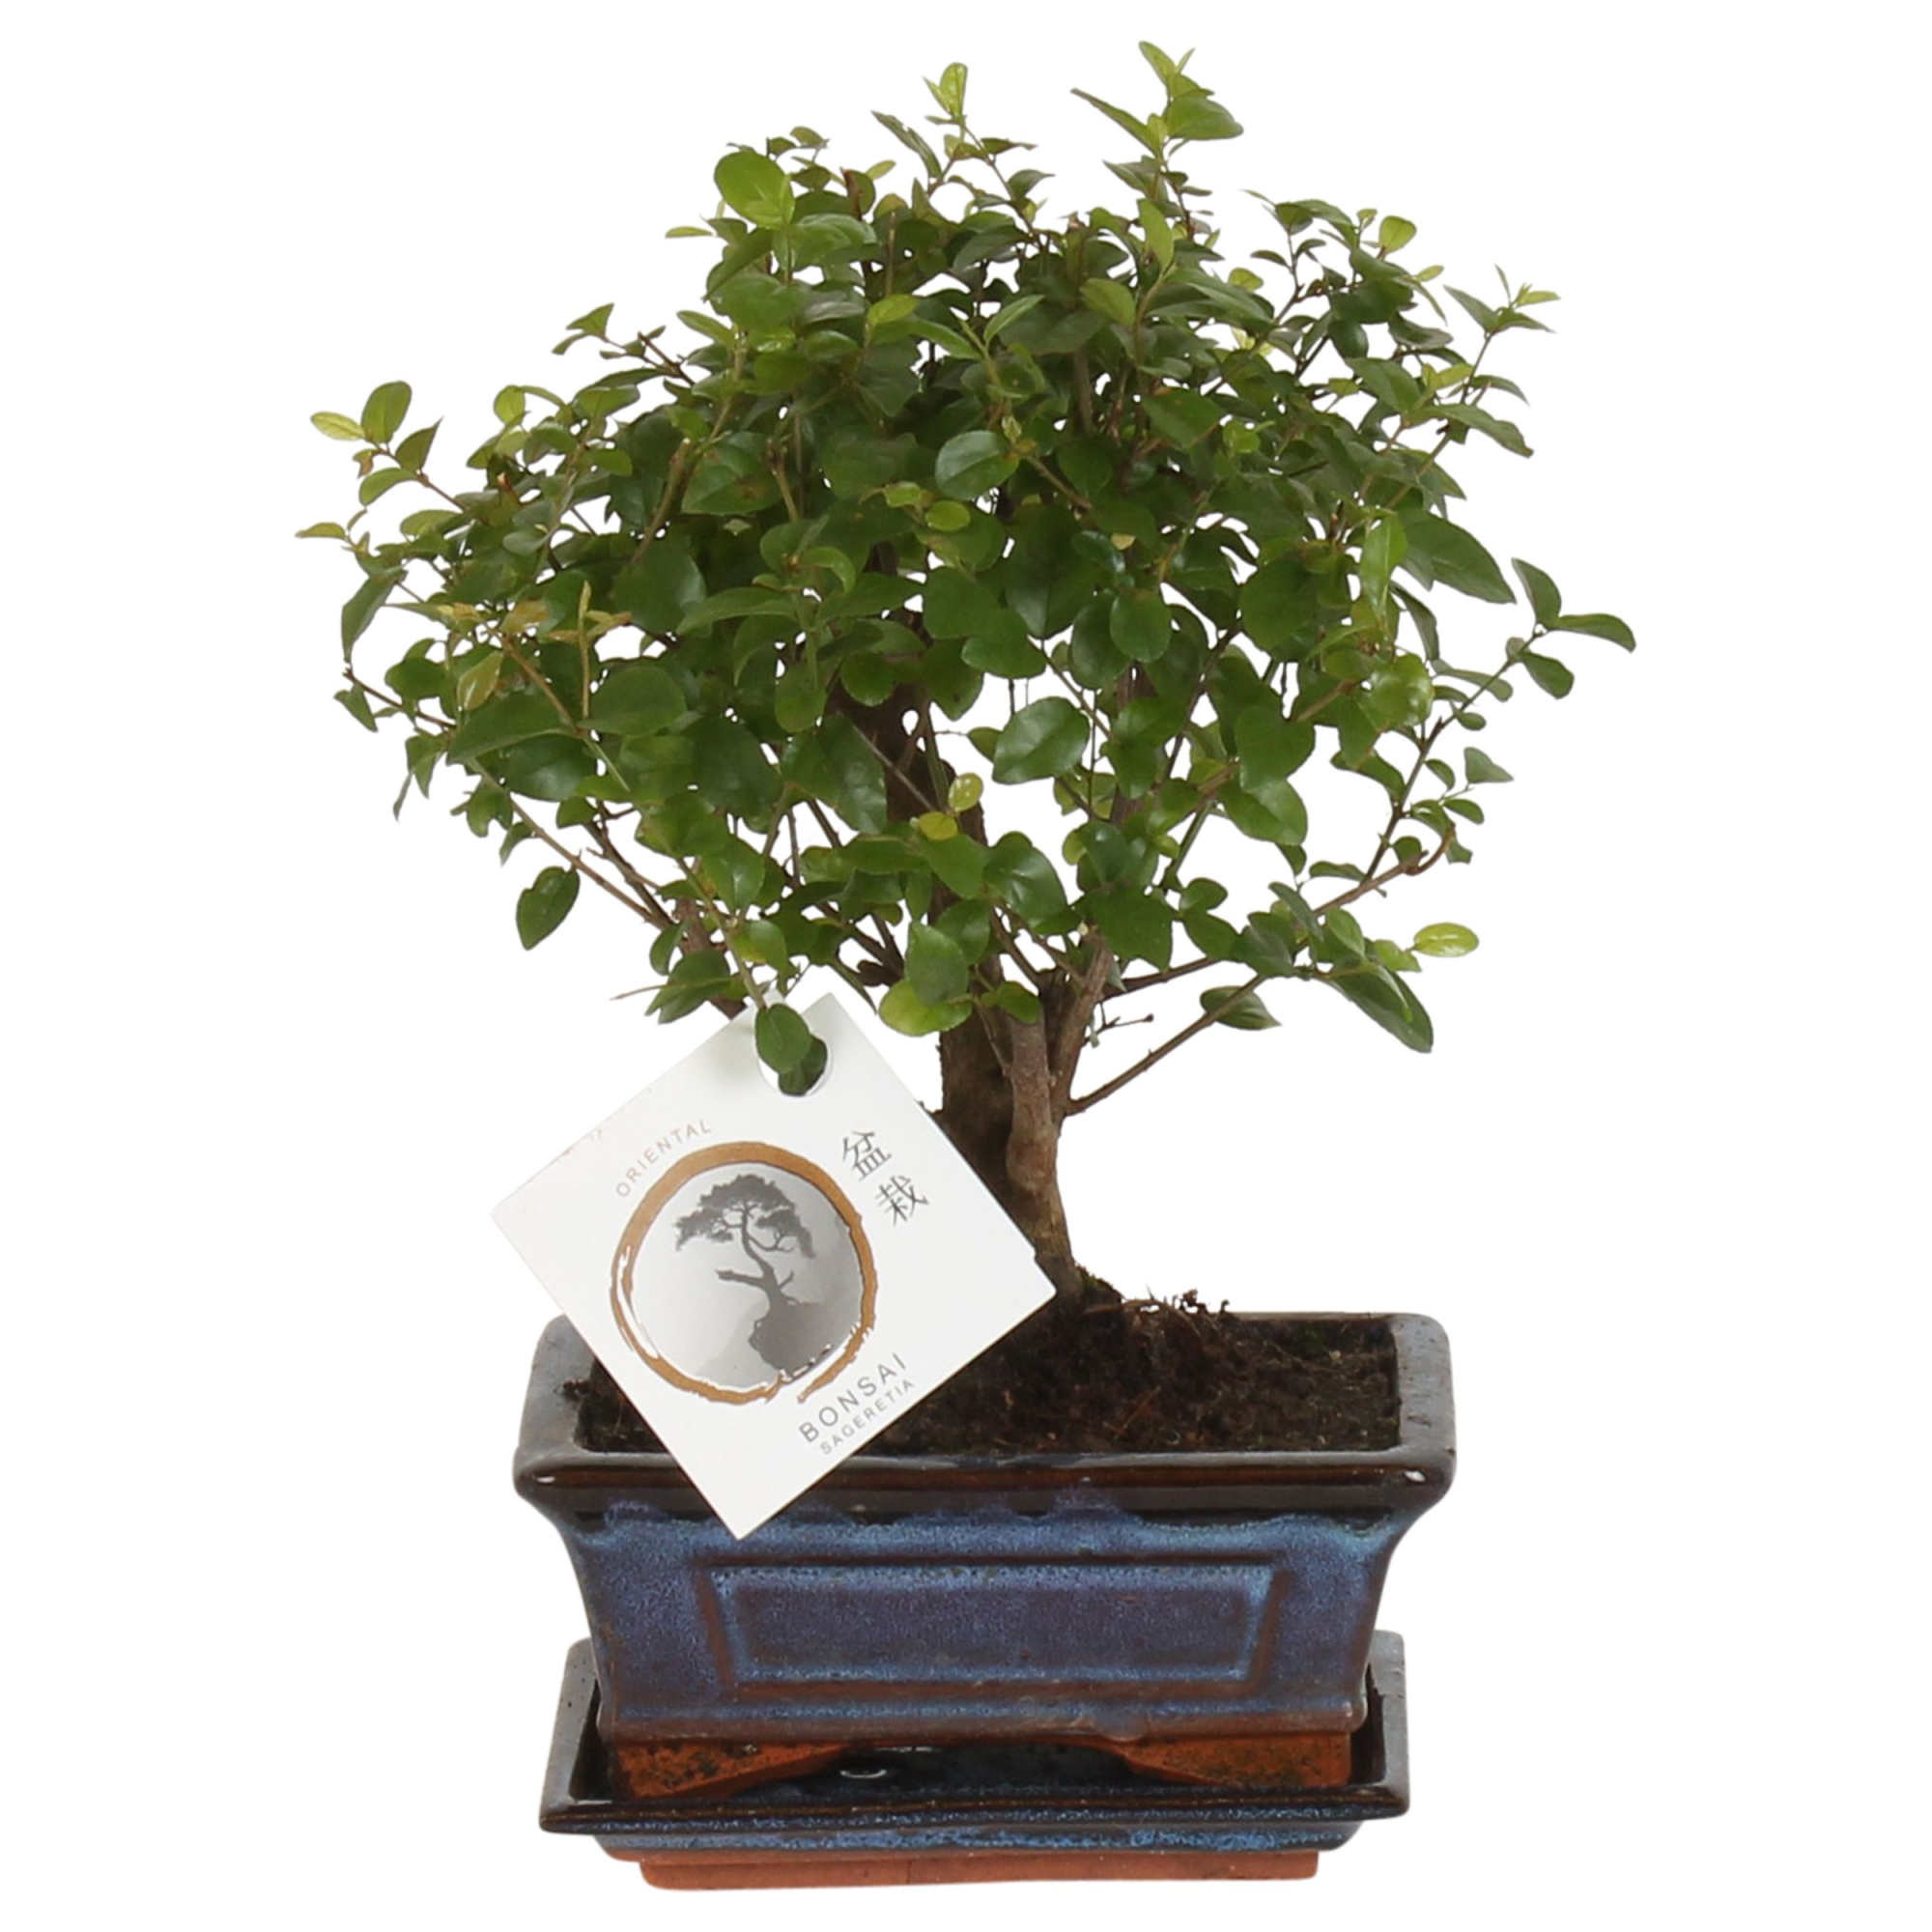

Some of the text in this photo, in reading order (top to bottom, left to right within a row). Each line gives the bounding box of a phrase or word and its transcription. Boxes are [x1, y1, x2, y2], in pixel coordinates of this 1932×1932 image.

[615, 1120, 712, 1198] ORIENTAL
[841, 1129, 929, 1227] 盆栽
[799, 1353, 907, 1443] BONSAI
[820, 1378, 915, 1455] SAGERETIA
